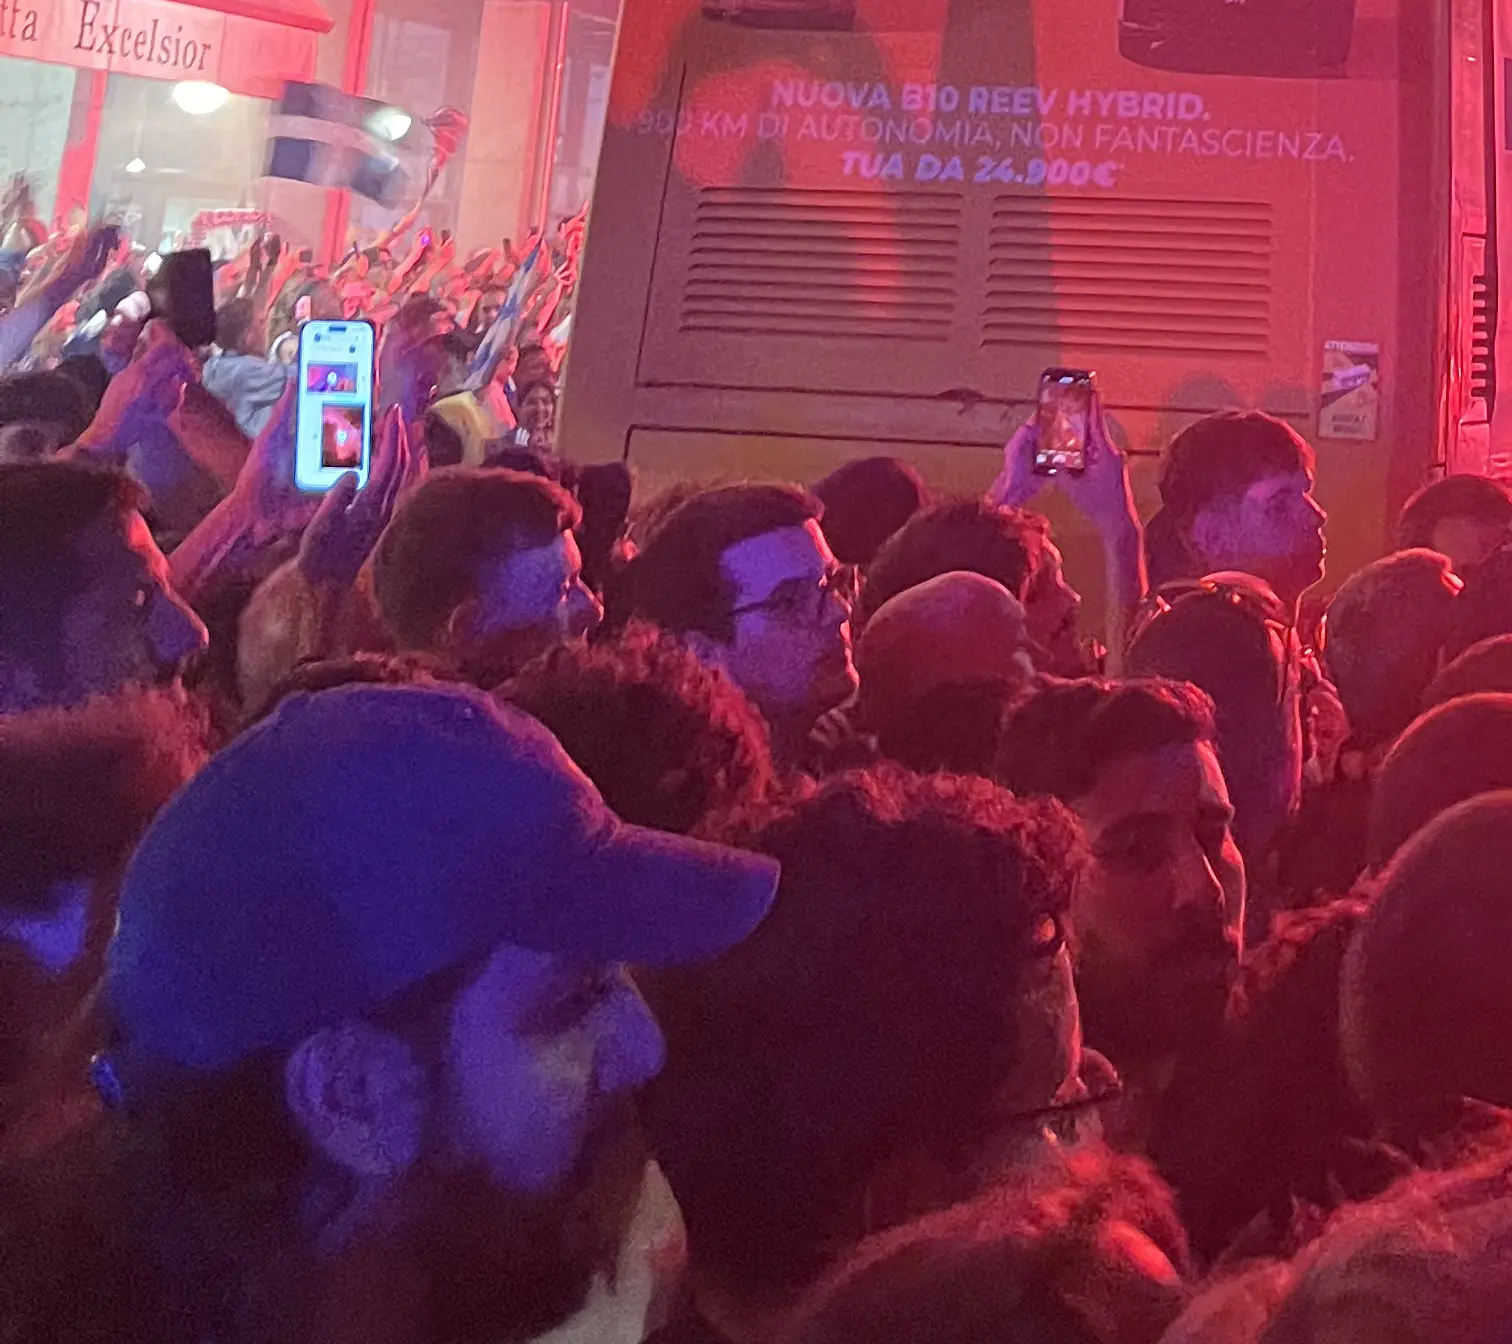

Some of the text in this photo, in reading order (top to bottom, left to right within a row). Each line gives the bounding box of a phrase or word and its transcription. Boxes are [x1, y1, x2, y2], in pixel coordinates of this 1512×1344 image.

[770, 80, 1212, 121] NUOVA B10 REEV HYBRID.
[701, 112, 748, 140] KM
[757, 114, 789, 142] DI
[797, 115, 1001, 150] AUTONOMIA,
[1009, 121, 1084, 150] NON
[1094, 123, 1356, 163] FANTASCIENZA.
[842, 150, 905, 180] TUA
[915, 154, 966, 183] DA
